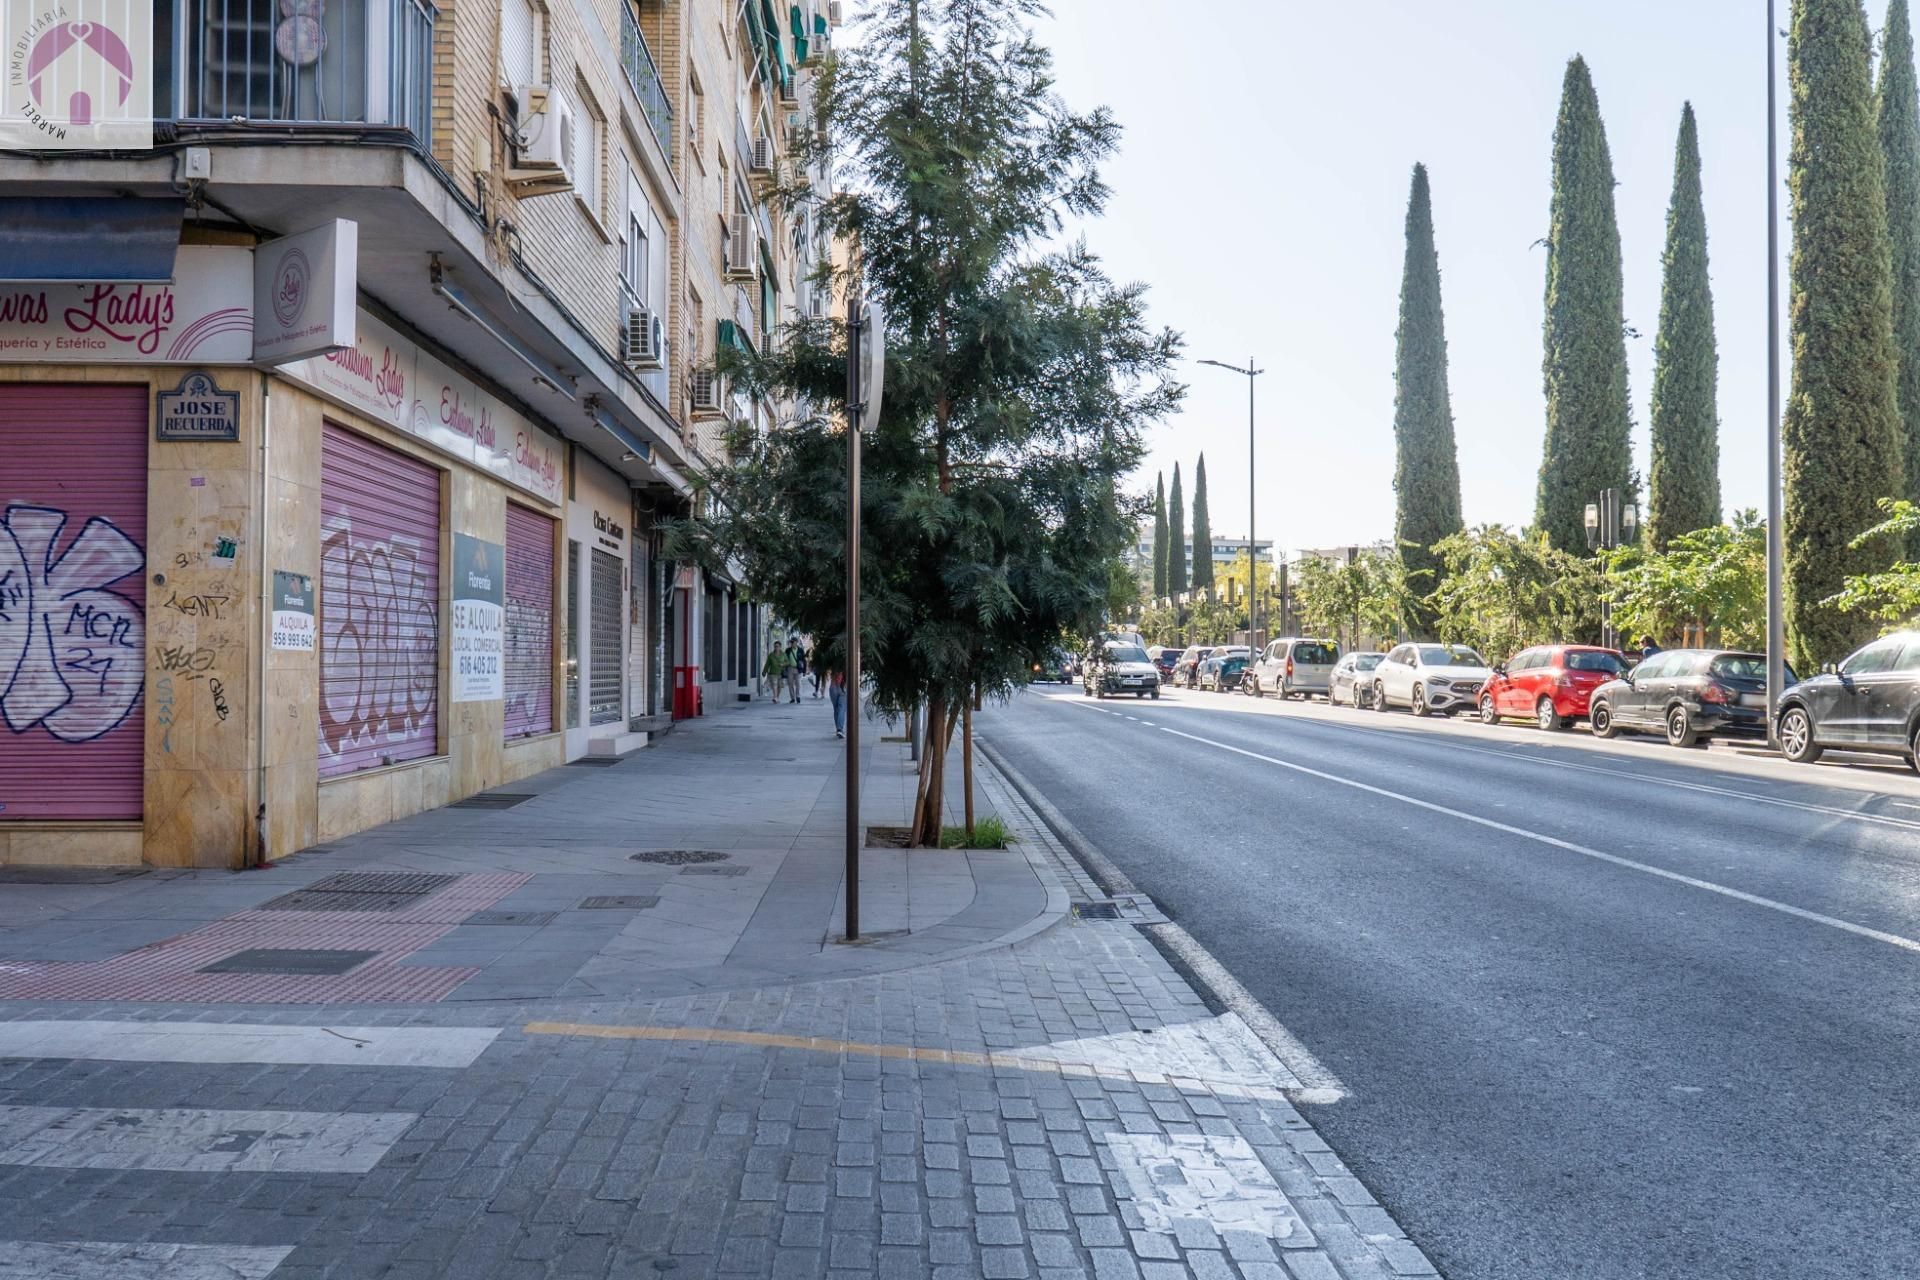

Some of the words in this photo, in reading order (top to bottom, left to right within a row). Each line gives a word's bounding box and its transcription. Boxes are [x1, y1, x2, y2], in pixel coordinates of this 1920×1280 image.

[64, 284, 173, 354] Lady's
[43, 340, 51, 351] y
[56, 337, 106, 349] Estética
[173, 401, 227, 416] JOSE
[165, 417, 234, 432] RECUERDA
[279, 616, 308, 630] ALQUILA
[454, 605, 466, 629] SE
[468, 607, 502, 633] ALQUILA
[273, 632, 287, 646] 958
[288, 633, 300, 647] 993
[301, 634, 313, 648] 642
[454, 637, 472, 652] LOCAL
[474, 637, 502, 653] COMERCIAL
[460, 655, 472, 674] 616
[473, 655, 485, 674] 405
